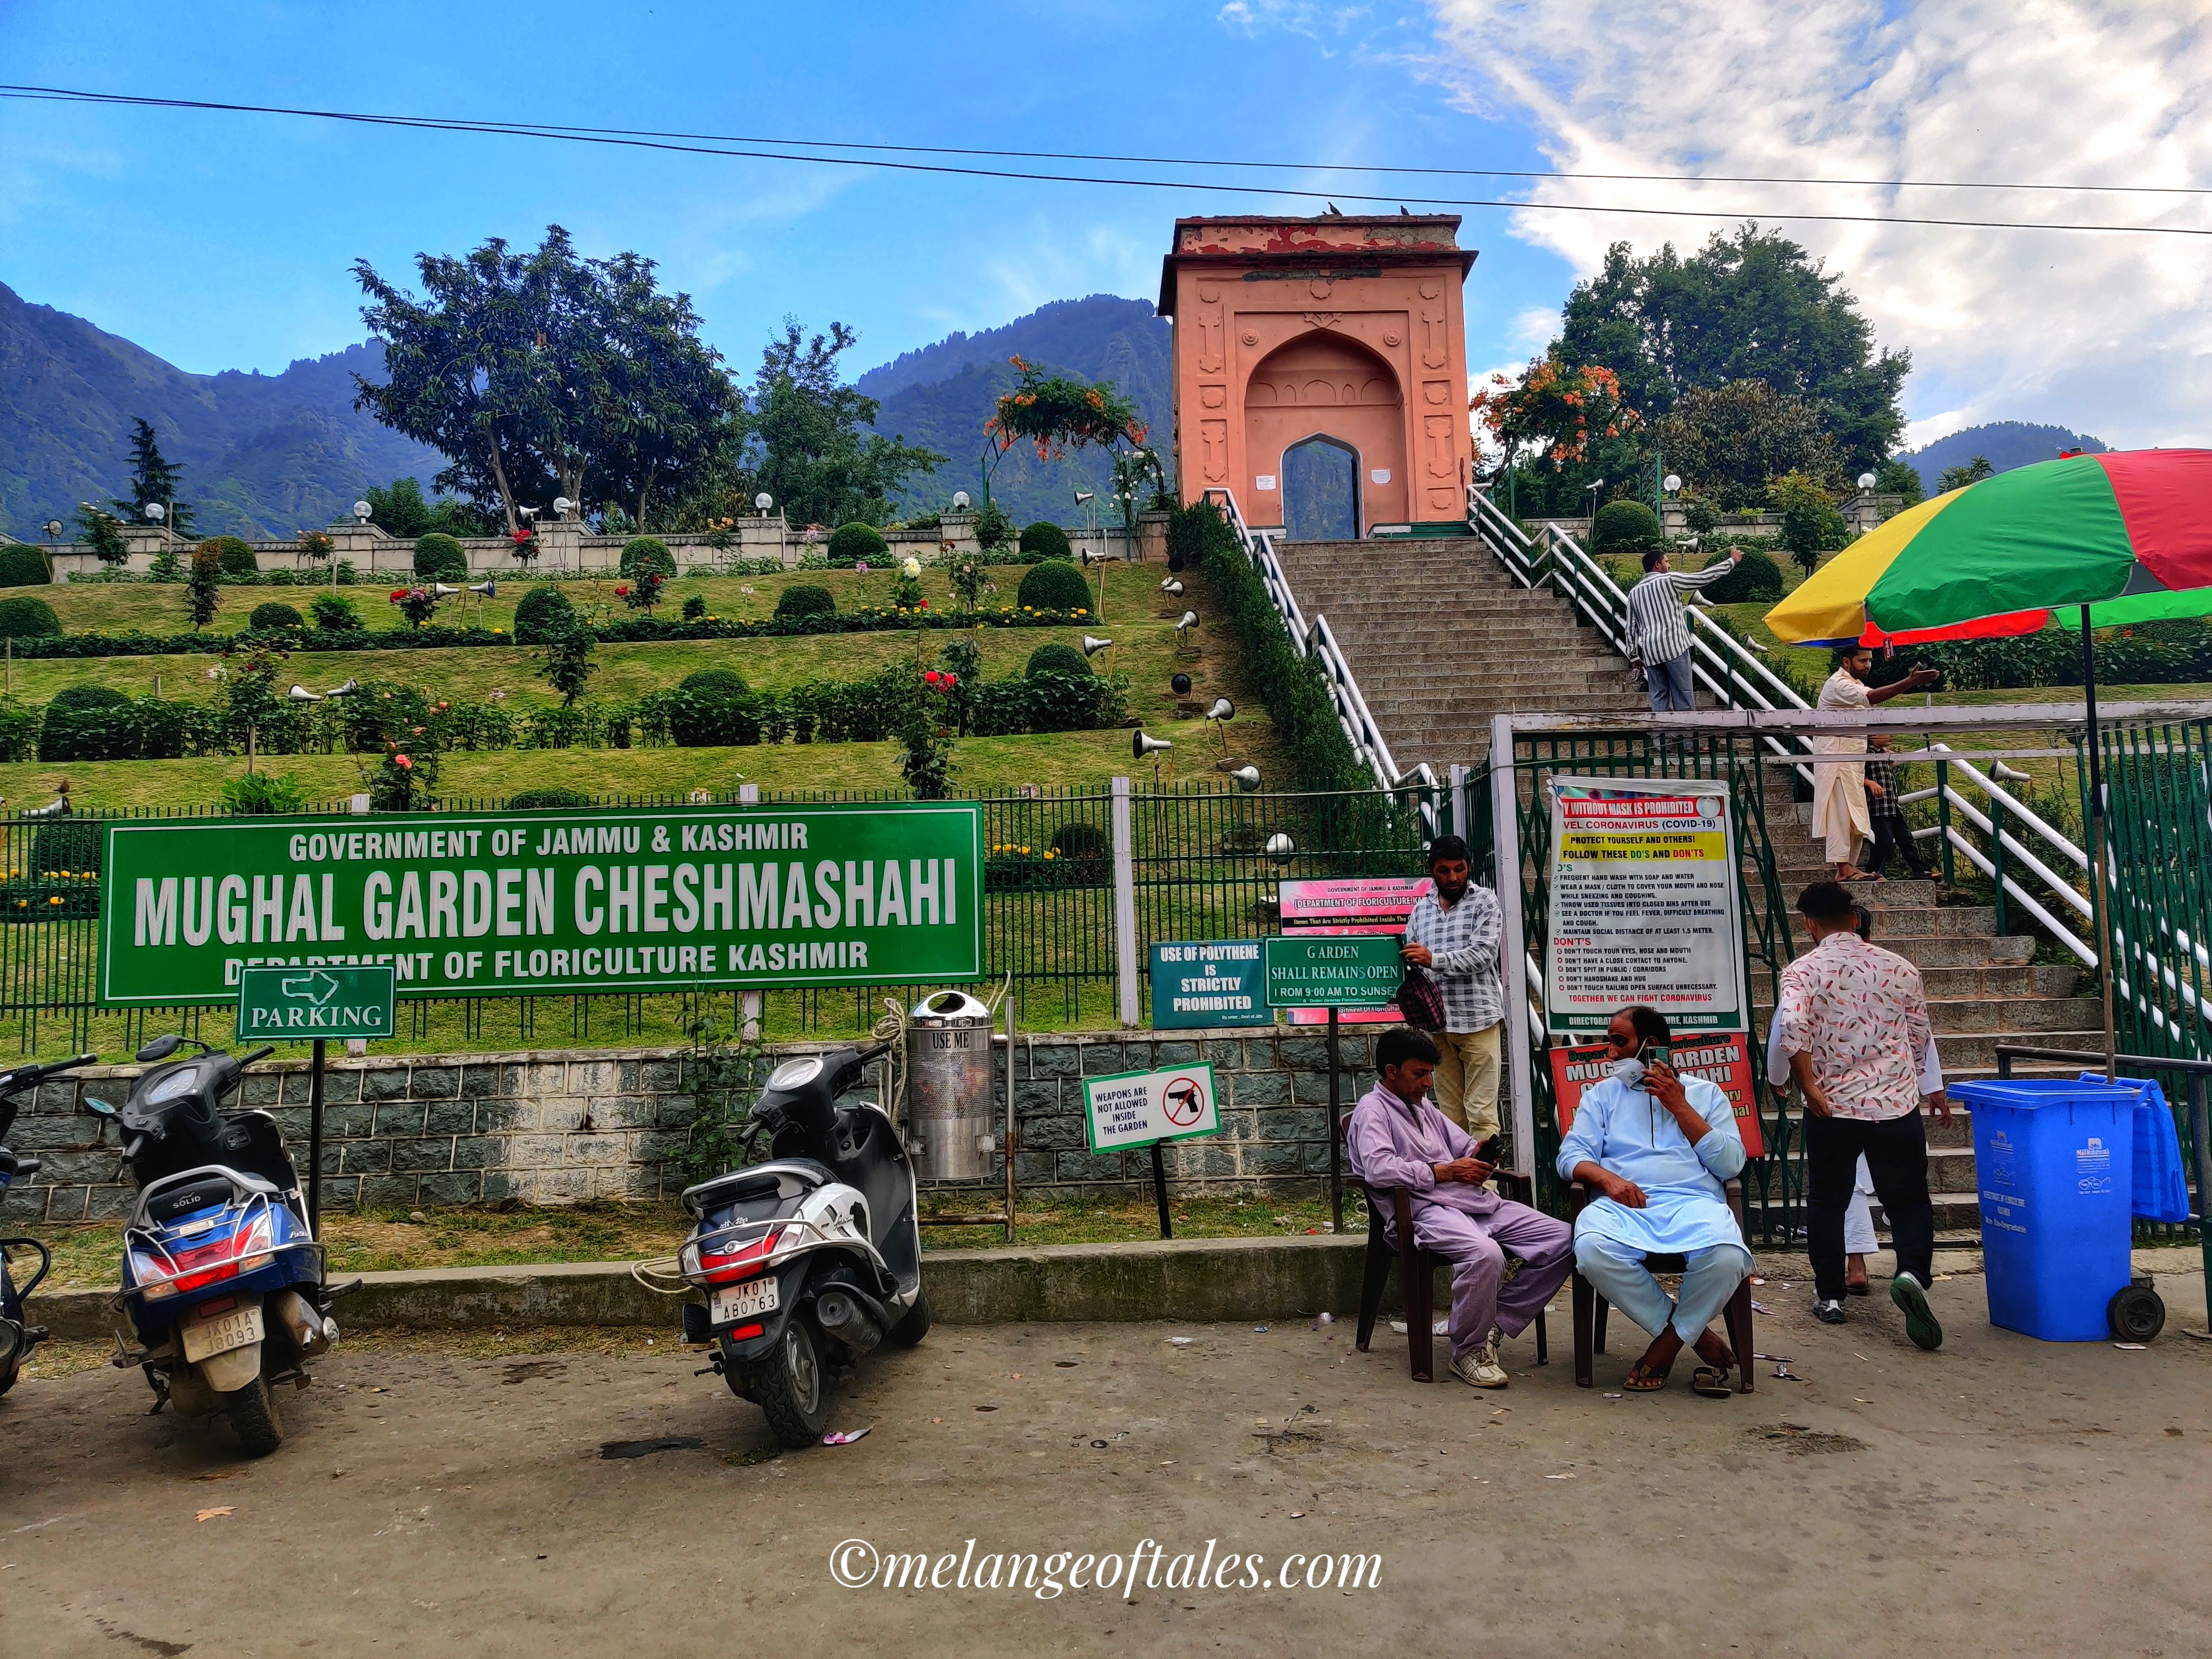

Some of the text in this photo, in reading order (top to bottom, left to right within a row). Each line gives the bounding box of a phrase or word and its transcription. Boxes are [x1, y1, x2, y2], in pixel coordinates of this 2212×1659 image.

[1571, 801, 1693, 816] WITHOUT MASK IS PROHIBITED
[1586, 821, 1658, 829] CORONAVIRUS
[1662, 820, 1715, 830] (COVID-19)
[289, 822, 807, 862] GOVERNMENT OF JAMMU & KASHMIR
[1652, 850, 1670, 858] AND
[1673, 849, 1704, 857] DON'TS
[133, 858, 956, 946] MUGHAL GARDEN CHESHMASHAHI
[1294, 898, 1344, 910] (DEPARTMENT
[1347, 898, 1356, 906] OF
[1358, 897, 1411, 906] FLORICULTURE
[1160, 945, 1259, 962] USE OF POLYTHENE
[1307, 946, 1359, 958] GARDEN
[444, 951, 483, 979] OF
[495, 945, 716, 978] FLORICULTURE
[729, 941, 868, 971] KASHMIR
[1204, 964, 1217, 976] IS
[1271, 966, 1398, 979] SHALL OPEN
[1181, 977, 1241, 993] STRICTLY
[1305, 987, 1358, 996] 9:00 AM TO
[1173, 995, 1252, 1012] PROHIBITED
[251, 1005, 382, 1027] PARKING
[1683, 1016, 1718, 1025] KASHMIR
[932, 1032, 969, 1049] USE ME
[1095, 1087, 1147, 1103] WEAPONS ARE
[1098, 1098, 1148, 1113] NOT ALLOWED
[1112, 1110, 1136, 1123] INSIDE
[1103, 1120, 1147, 1135] THE GARDEN
[173, 1196, 201, 1209] SOLID
[736, 1280, 768, 1300] JK01
[724, 1294, 775, 1320] AB0763
